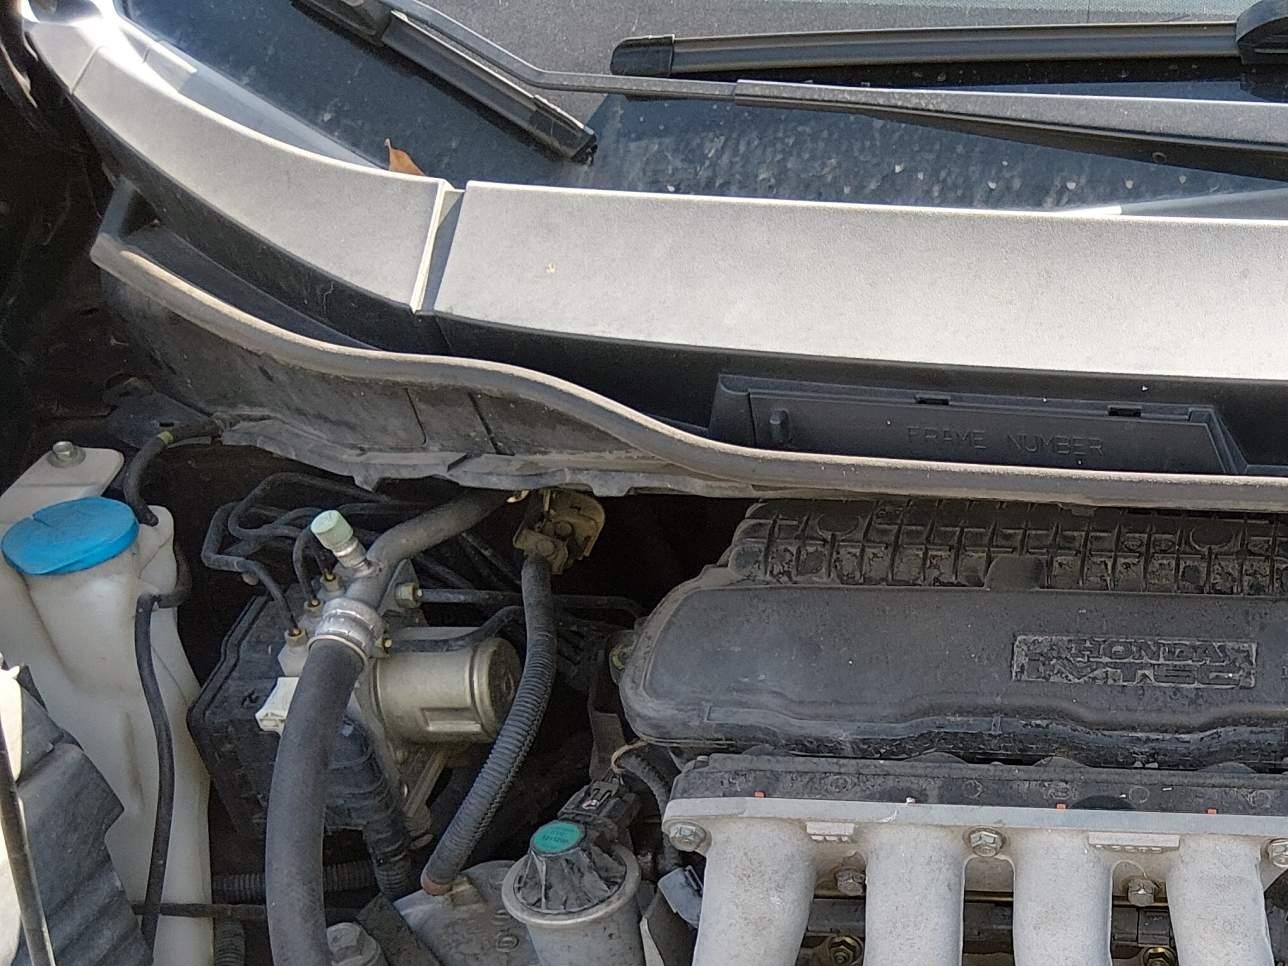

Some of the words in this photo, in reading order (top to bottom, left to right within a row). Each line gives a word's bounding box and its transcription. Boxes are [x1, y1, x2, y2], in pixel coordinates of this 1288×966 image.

[906, 425, 988, 449] FRAME
[1007, 432, 1104, 456] NUMBER
[1072, 638, 1230, 663] HONDA
